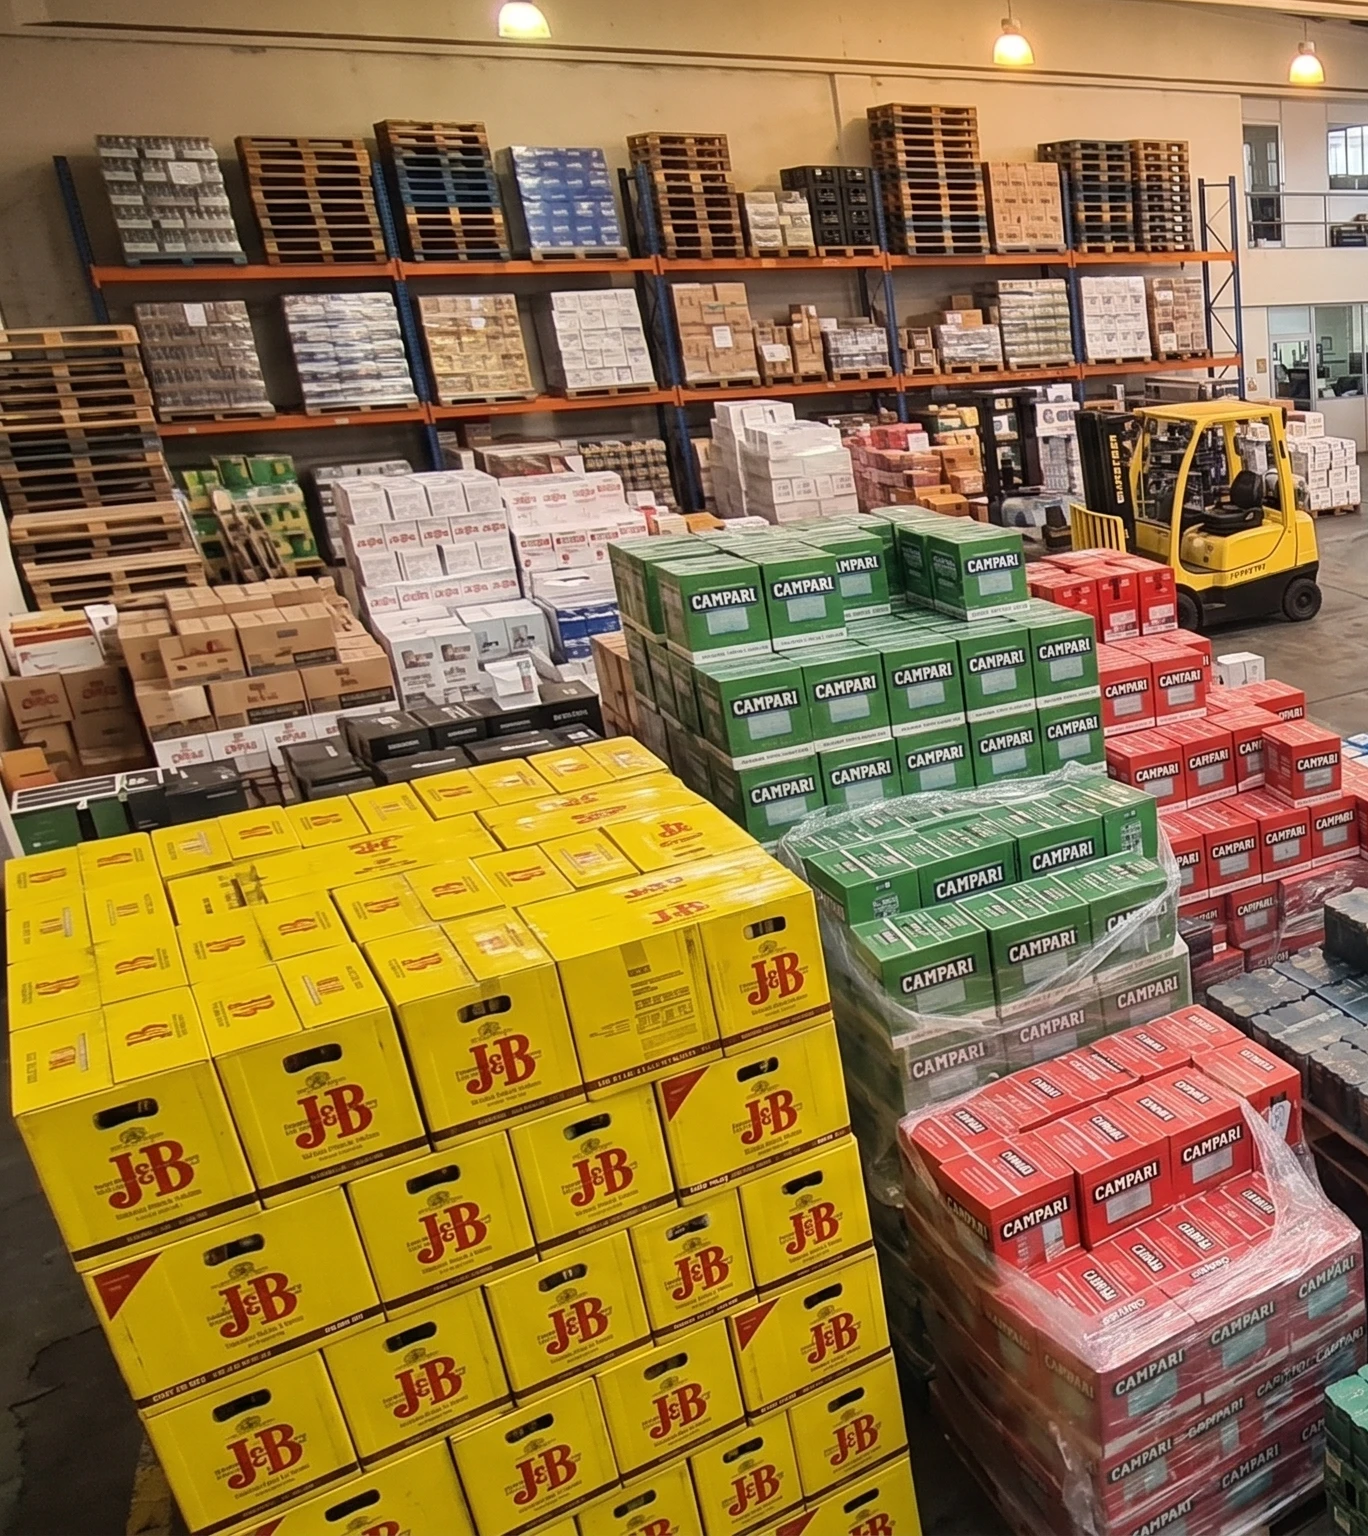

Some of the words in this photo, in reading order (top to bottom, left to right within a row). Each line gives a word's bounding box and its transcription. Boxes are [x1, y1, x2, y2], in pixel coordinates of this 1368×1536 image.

[836, 556, 879, 573] MPARI
[967, 553, 1018, 574] CAMPARI
[692, 587, 757, 610] CAMPARI
[773, 576, 835, 597] CAMPARI
[1039, 638, 1091, 660] CAMPARI
[815, 675, 876, 699] CAMPARI
[894, 662, 952, 686] CAMPARI
[1105, 679, 1148, 698] CAMPARI
[733, 690, 798, 715] CAMPARI
[980, 730, 1033, 754] CAMPARI
[1047, 716, 1098, 740] CAMPARI
[907, 745, 964, 769] CAMPARI
[751, 777, 814, 803] CAMPARI
[1032, 840, 1094, 871] CAMPARI
[1176, 851, 1199, 867] PARI
[1212, 838, 1255, 858] CAMPARI
[936, 866, 1004, 899] CAMPARI
[1009, 930, 1076, 962] CAMPARI
[747, 951, 804, 1006] J&B
[903, 957, 974, 993] CAMPARI
[1117, 975, 1179, 1009] CAMPARI
[1020, 1010, 1085, 1042] CAMPARI
[466, 1033, 537, 1095] J&B
[912, 1042, 985, 1079] CAMPARI
[295, 1083, 374, 1150] J&B
[740, 1089, 799, 1145] J&B
[1183, 1126, 1242, 1163] CAMPARI
[108, 1139, 195, 1210] J&B
[570, 1147, 634, 1206] J&B
[1095, 1162, 1158, 1201] CAMPARI
[417, 1201, 488, 1265] J&B
[785, 1201, 840, 1256] J&B
[1002, 1197, 1069, 1239] CAMPARI
[671, 1245, 731, 1302] J&B
[1299, 1255, 1355, 1299] CAMPARI
[218, 1272, 298, 1339] J&B
[1211, 1302, 1275, 1345] CAMPARI
[545, 1296, 610, 1356] J&B
[806, 1311, 859, 1365] J&B
[392, 1356, 463, 1419] J&B
[1115, 1350, 1184, 1396] CAMPARI
[648, 1382, 708, 1440] J&B
[226, 1423, 304, 1490] J&B
[829, 1414, 879, 1467] J&B
[1111, 1438, 1172, 1482] CAMPARI
[512, 1443, 579, 1506] J&B
[1222, 1444, 1280, 1489] CAMPARI
[727, 1463, 780, 1517] J&B
